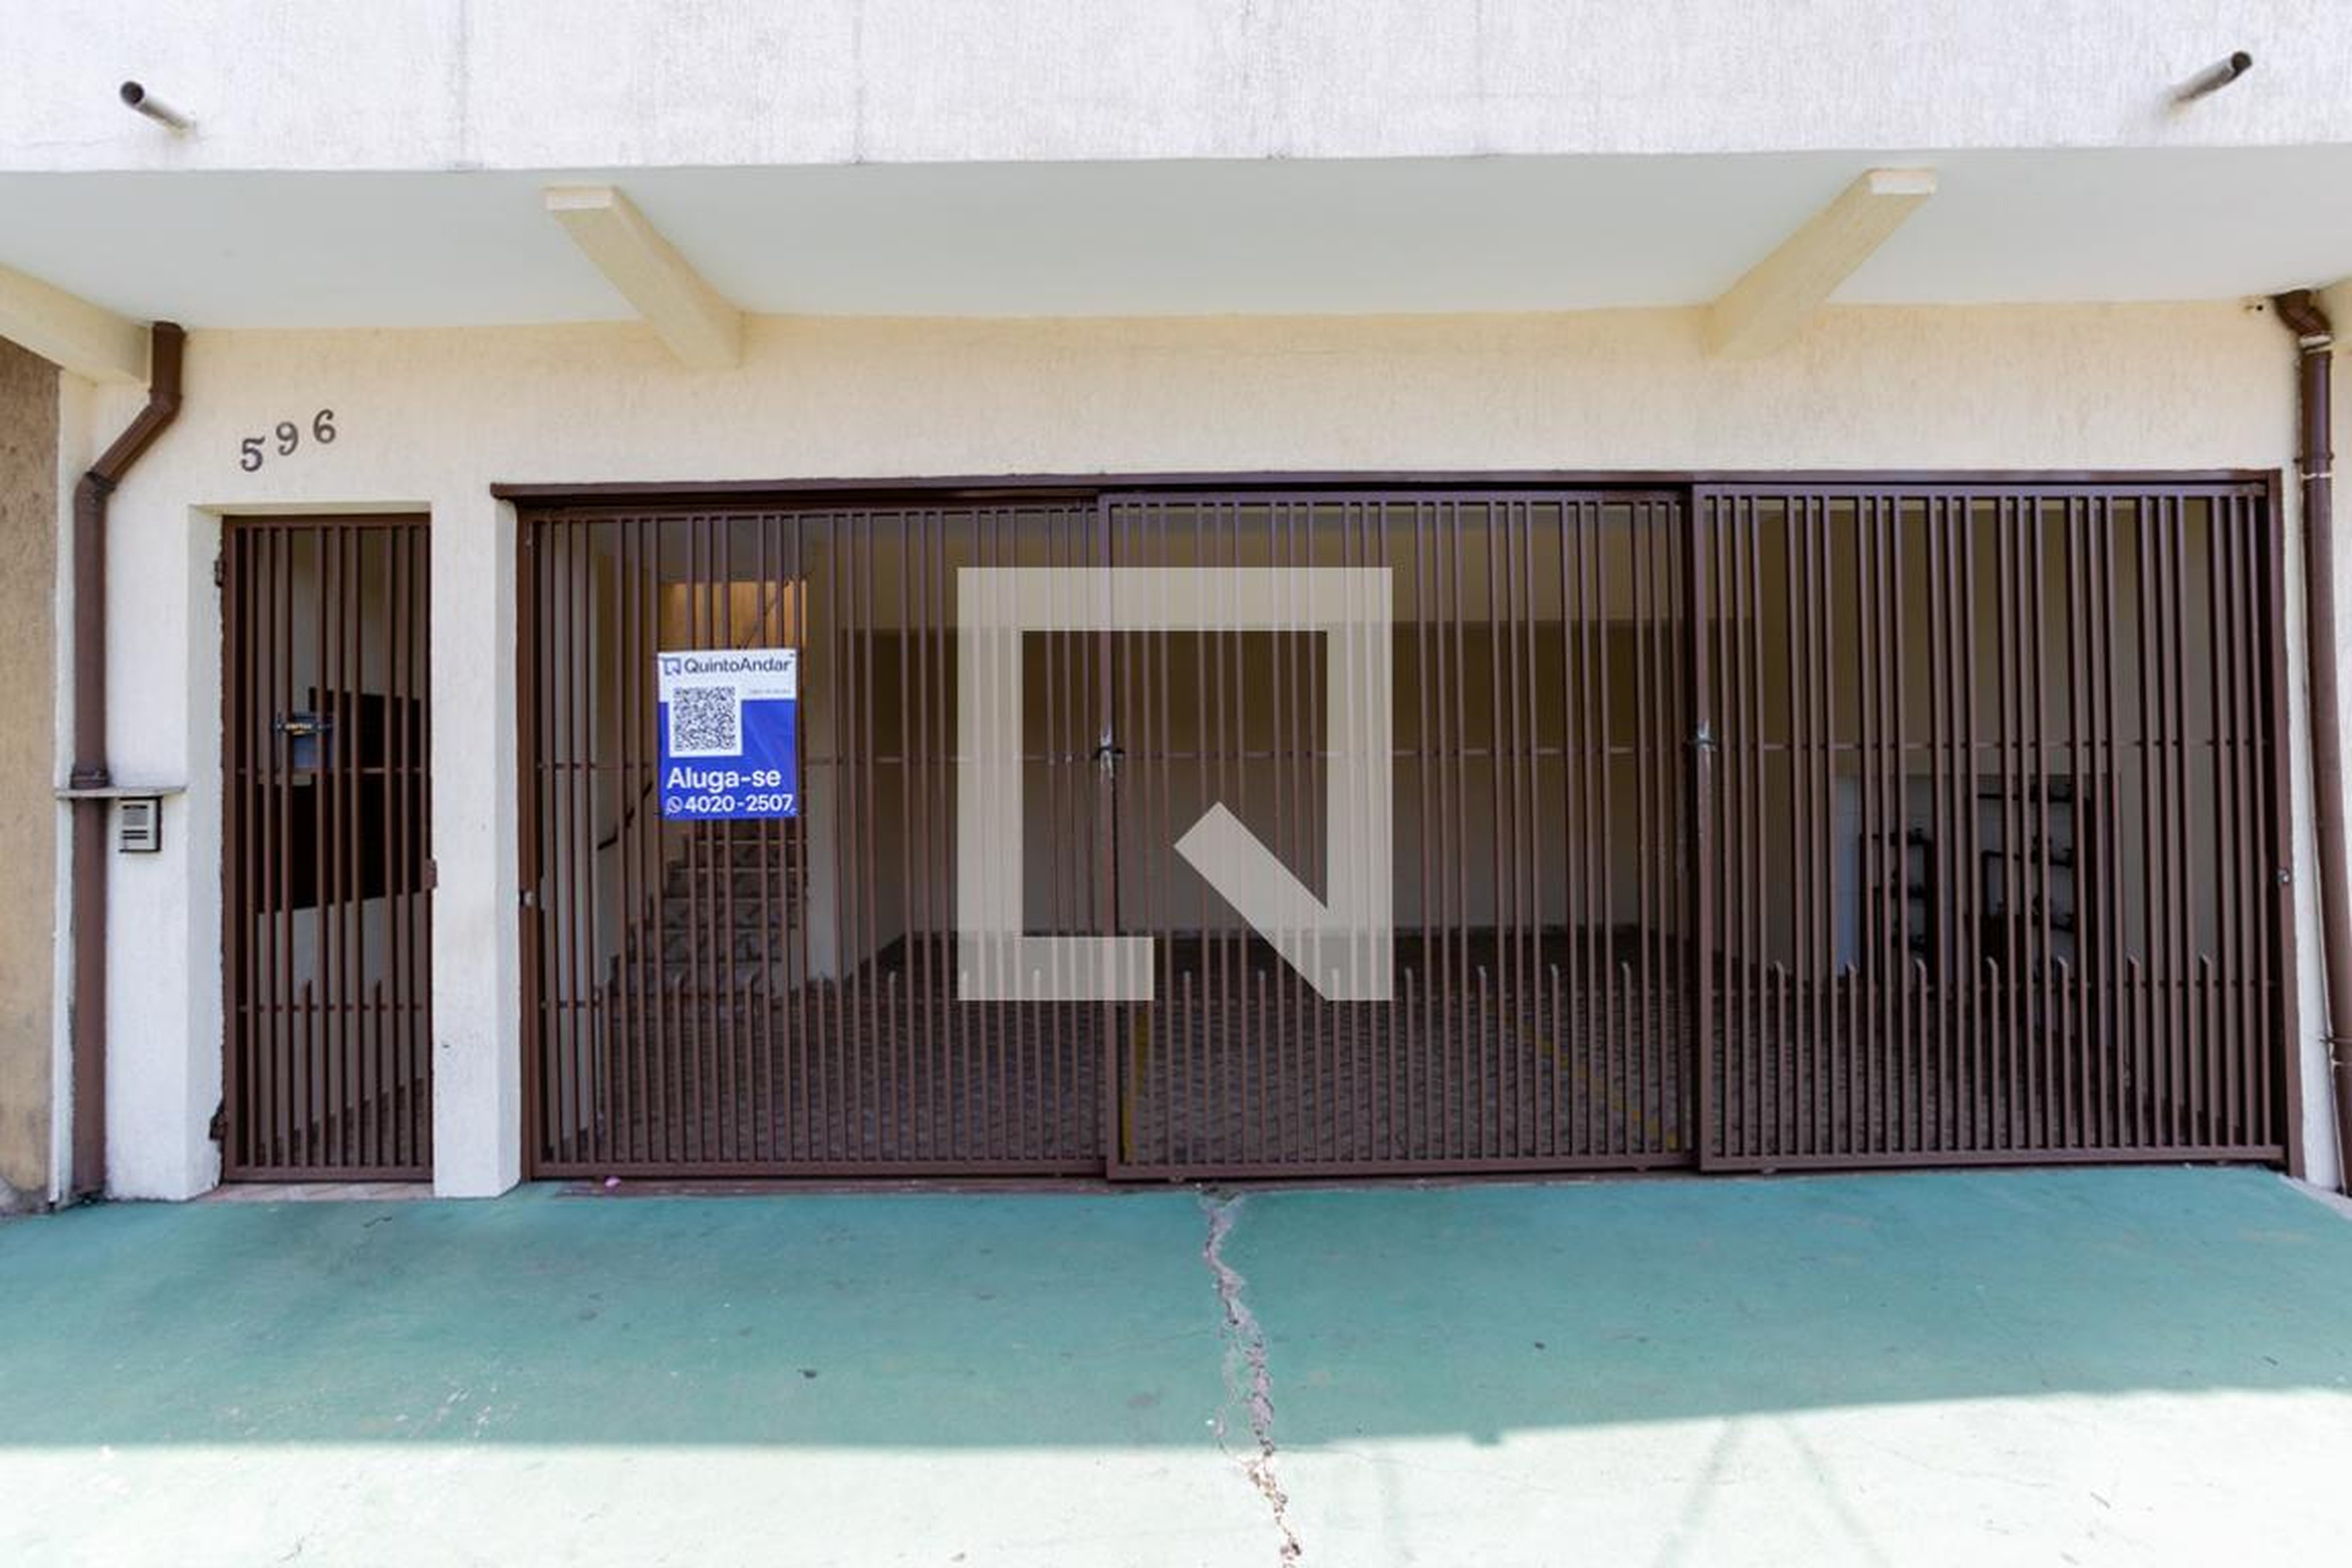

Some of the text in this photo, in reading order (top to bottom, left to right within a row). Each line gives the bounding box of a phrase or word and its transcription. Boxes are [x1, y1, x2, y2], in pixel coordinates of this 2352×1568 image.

[241, 409, 336, 472] 596
[684, 657, 791, 674] QuintoAndar
[667, 767, 782, 793] Aluga-se
[684, 794, 794, 813] 4020-2507
